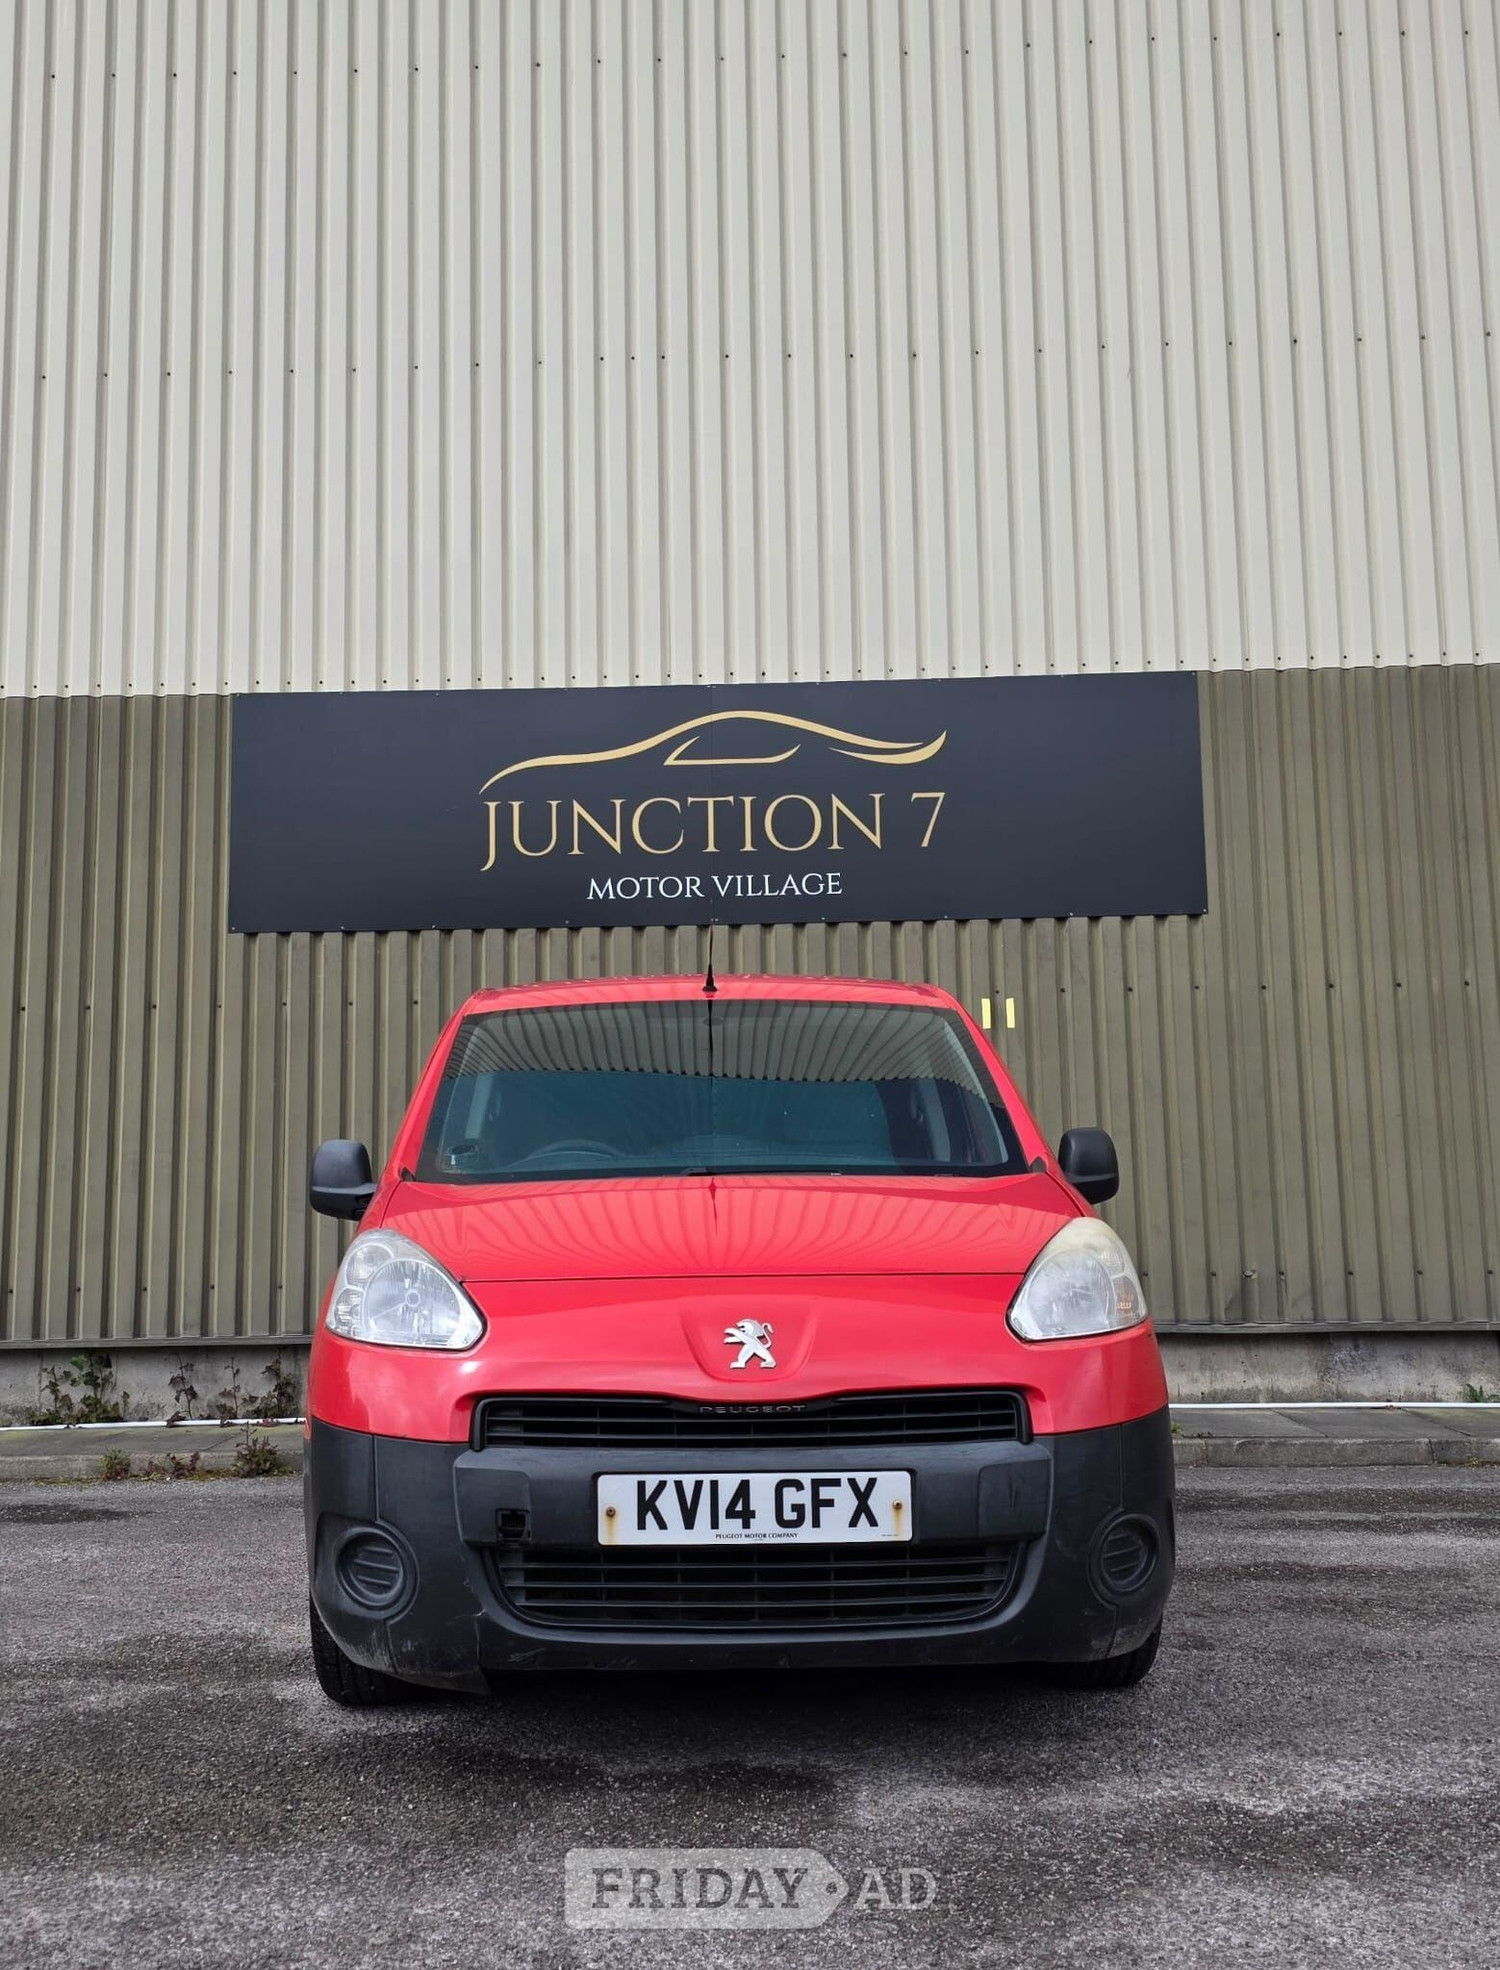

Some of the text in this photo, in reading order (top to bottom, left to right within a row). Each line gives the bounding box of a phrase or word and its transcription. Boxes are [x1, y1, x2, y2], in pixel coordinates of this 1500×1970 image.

[480, 792, 946, 872] JUNCTION 7
[586, 872, 843, 900] MOTOR VILLAGE
[700, 1405, 806, 1414] PEUGEOT
[636, 1477, 879, 1531] KV14 GFX
